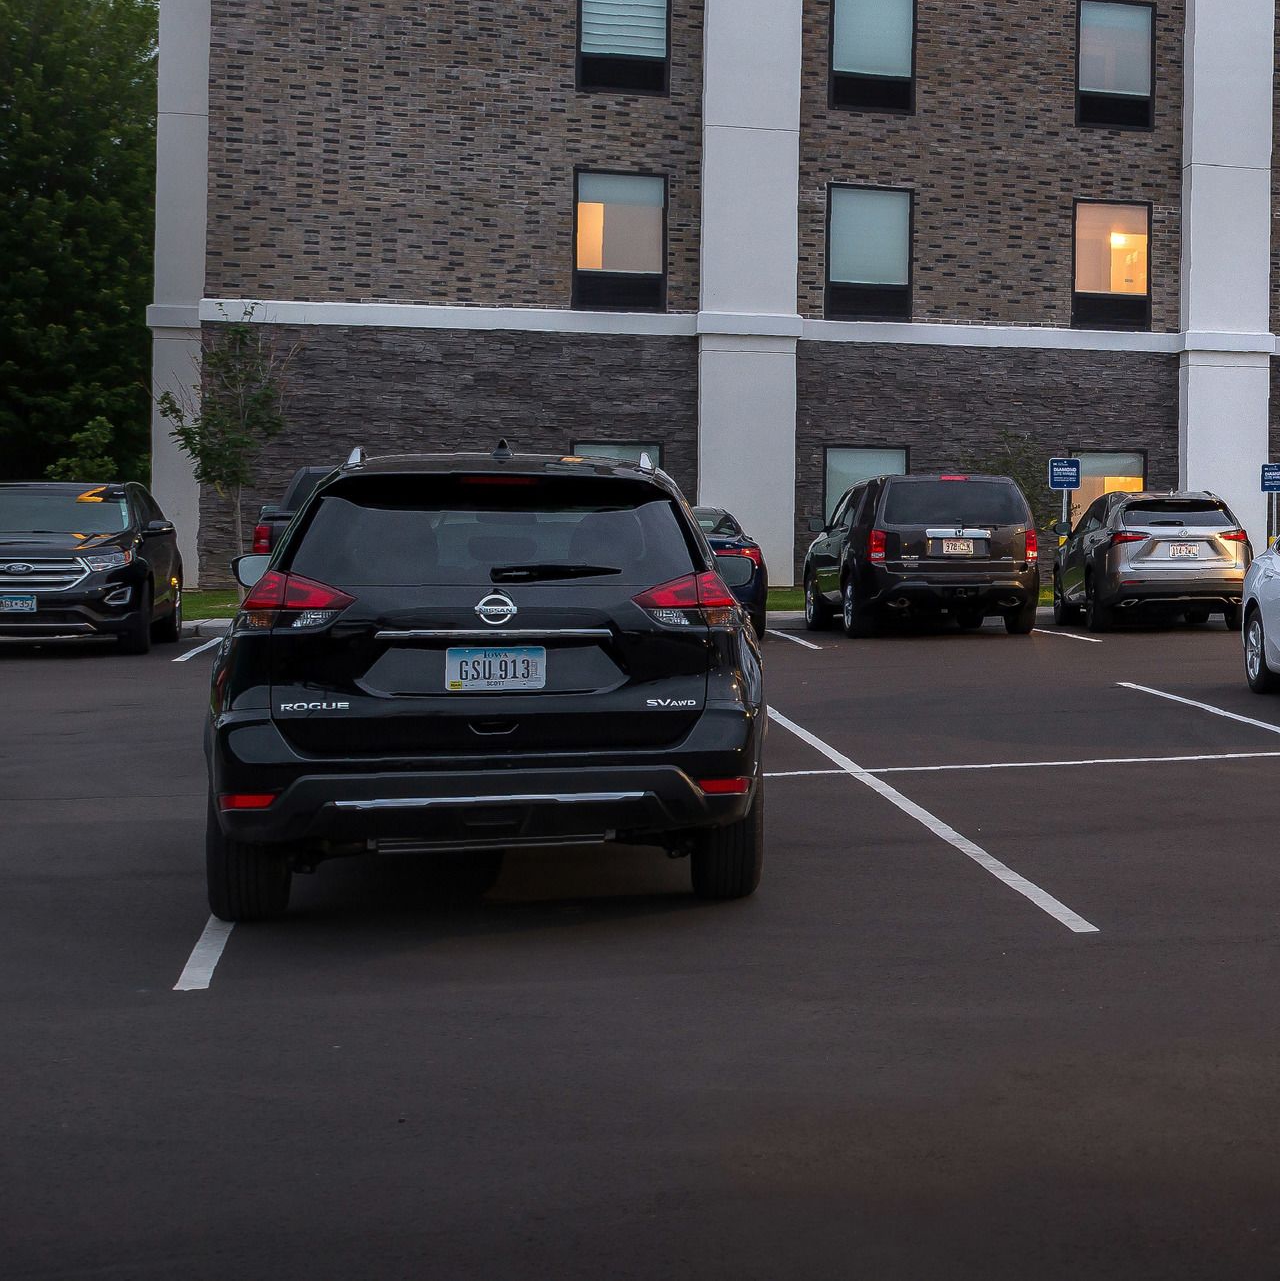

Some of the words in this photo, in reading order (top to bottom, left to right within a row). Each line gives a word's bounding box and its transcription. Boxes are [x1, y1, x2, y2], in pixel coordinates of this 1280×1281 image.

[459, 660, 492, 680] GSU
[499, 659, 530, 680] 913
[280, 702, 350, 712] ROGUE
[646, 699, 671, 707] SV
